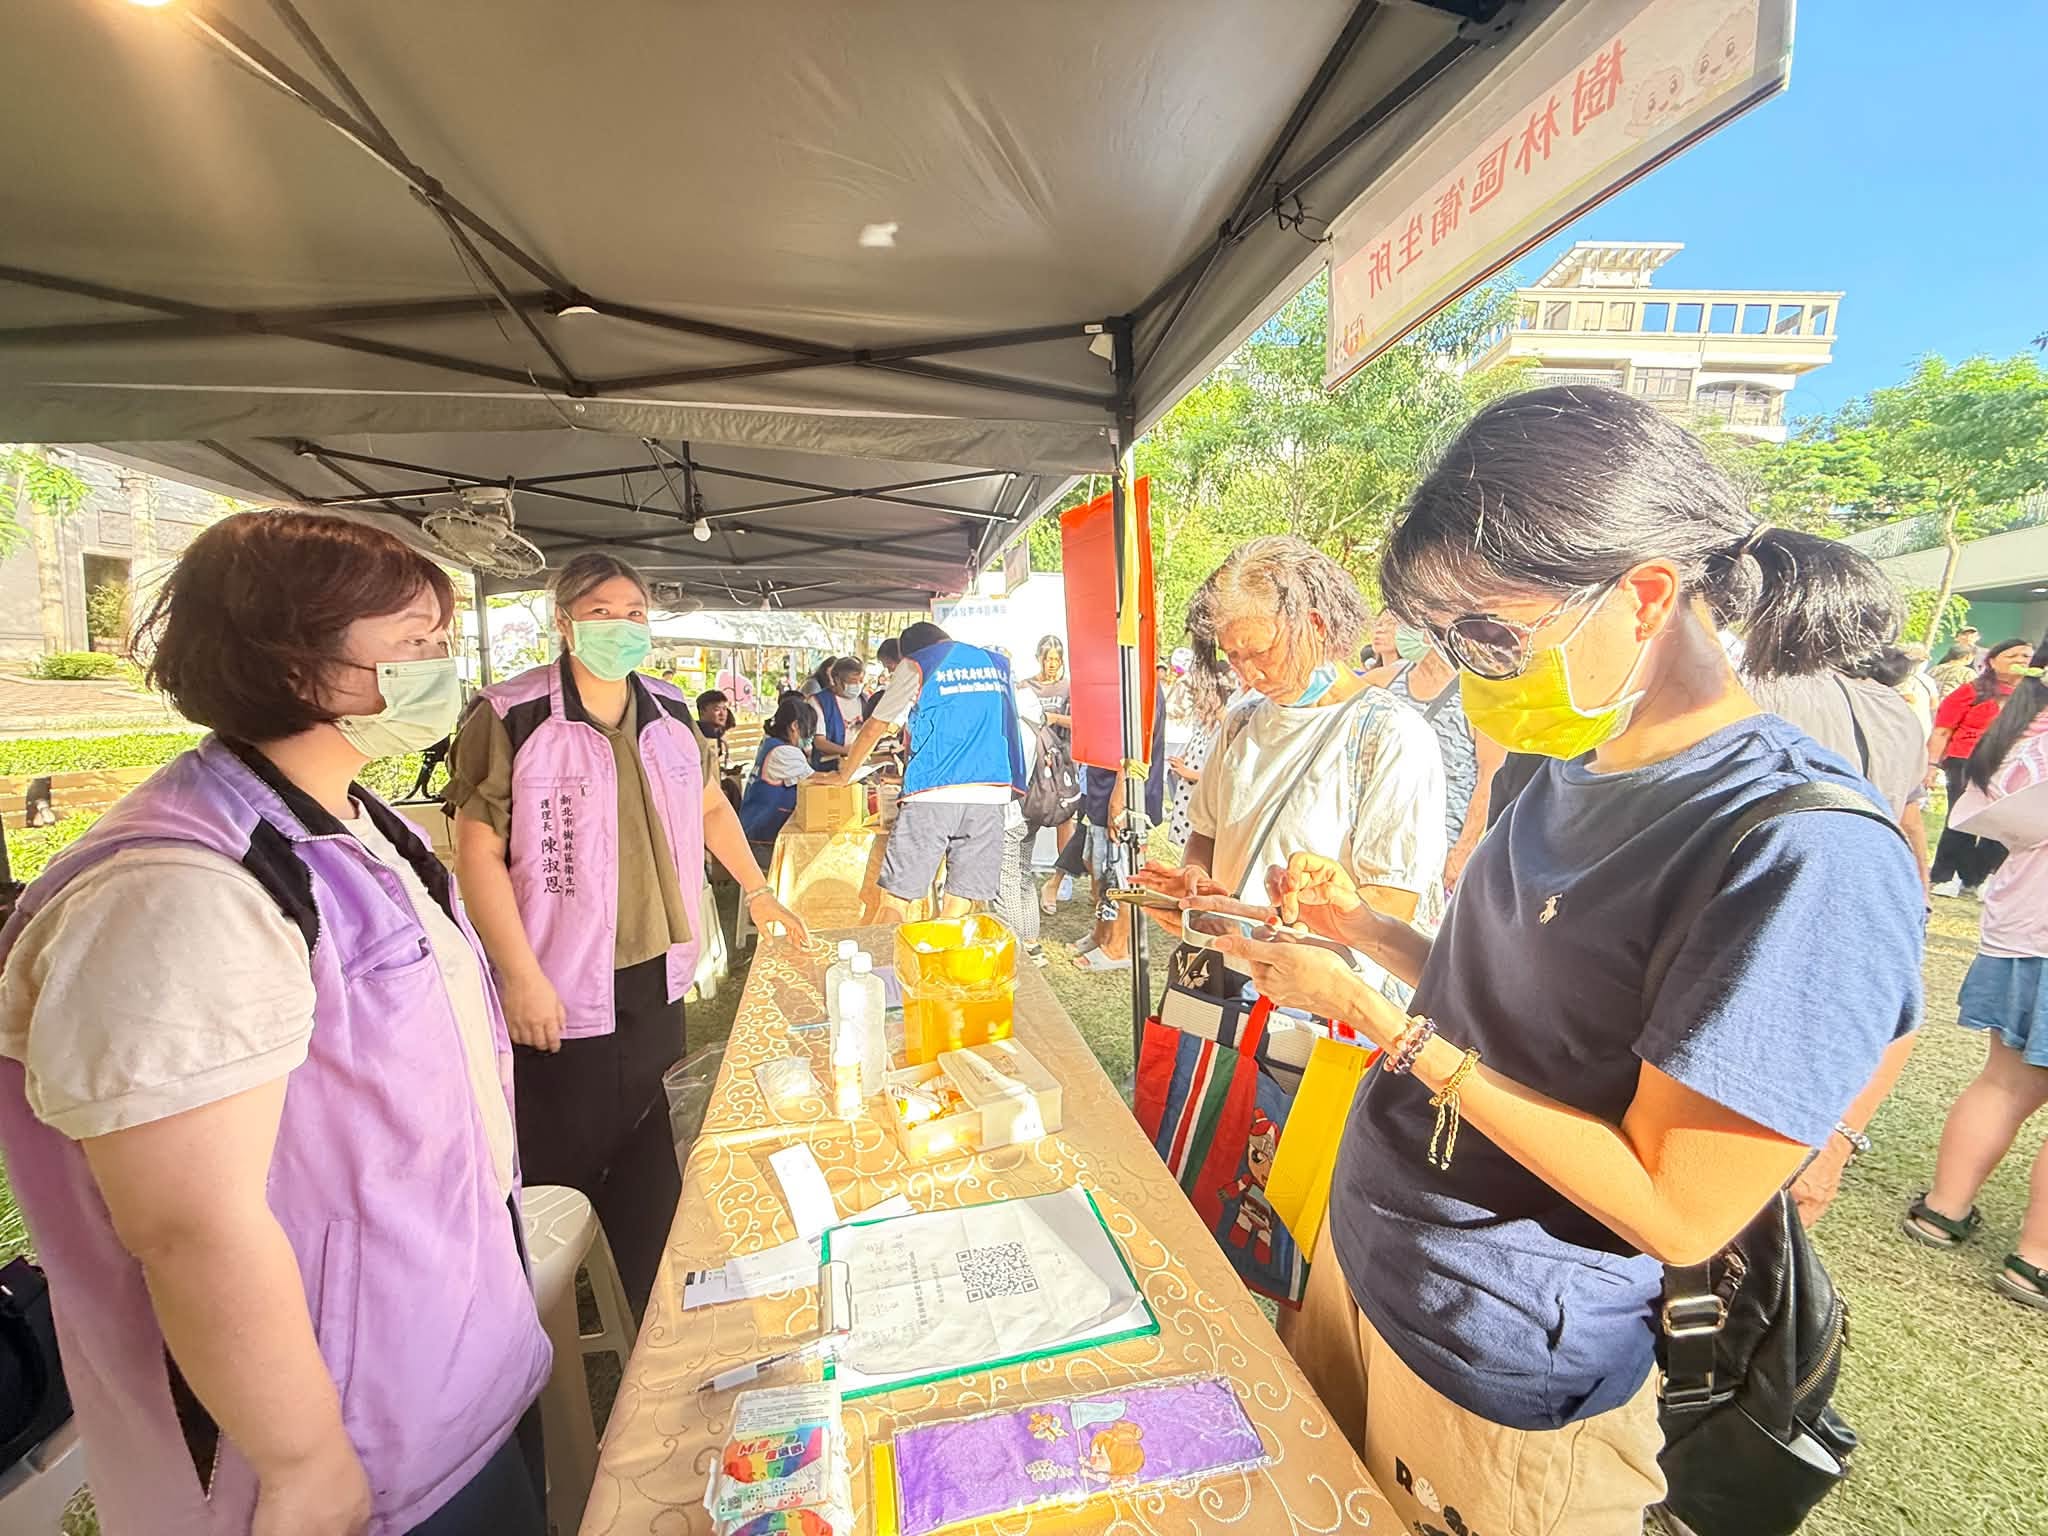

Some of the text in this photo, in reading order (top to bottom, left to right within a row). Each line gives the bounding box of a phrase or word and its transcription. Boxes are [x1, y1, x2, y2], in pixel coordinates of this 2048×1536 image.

[540, 798, 562, 894] 護理長 陳淑恩
[559, 794, 576, 898] 新北市樹林區衛生所
